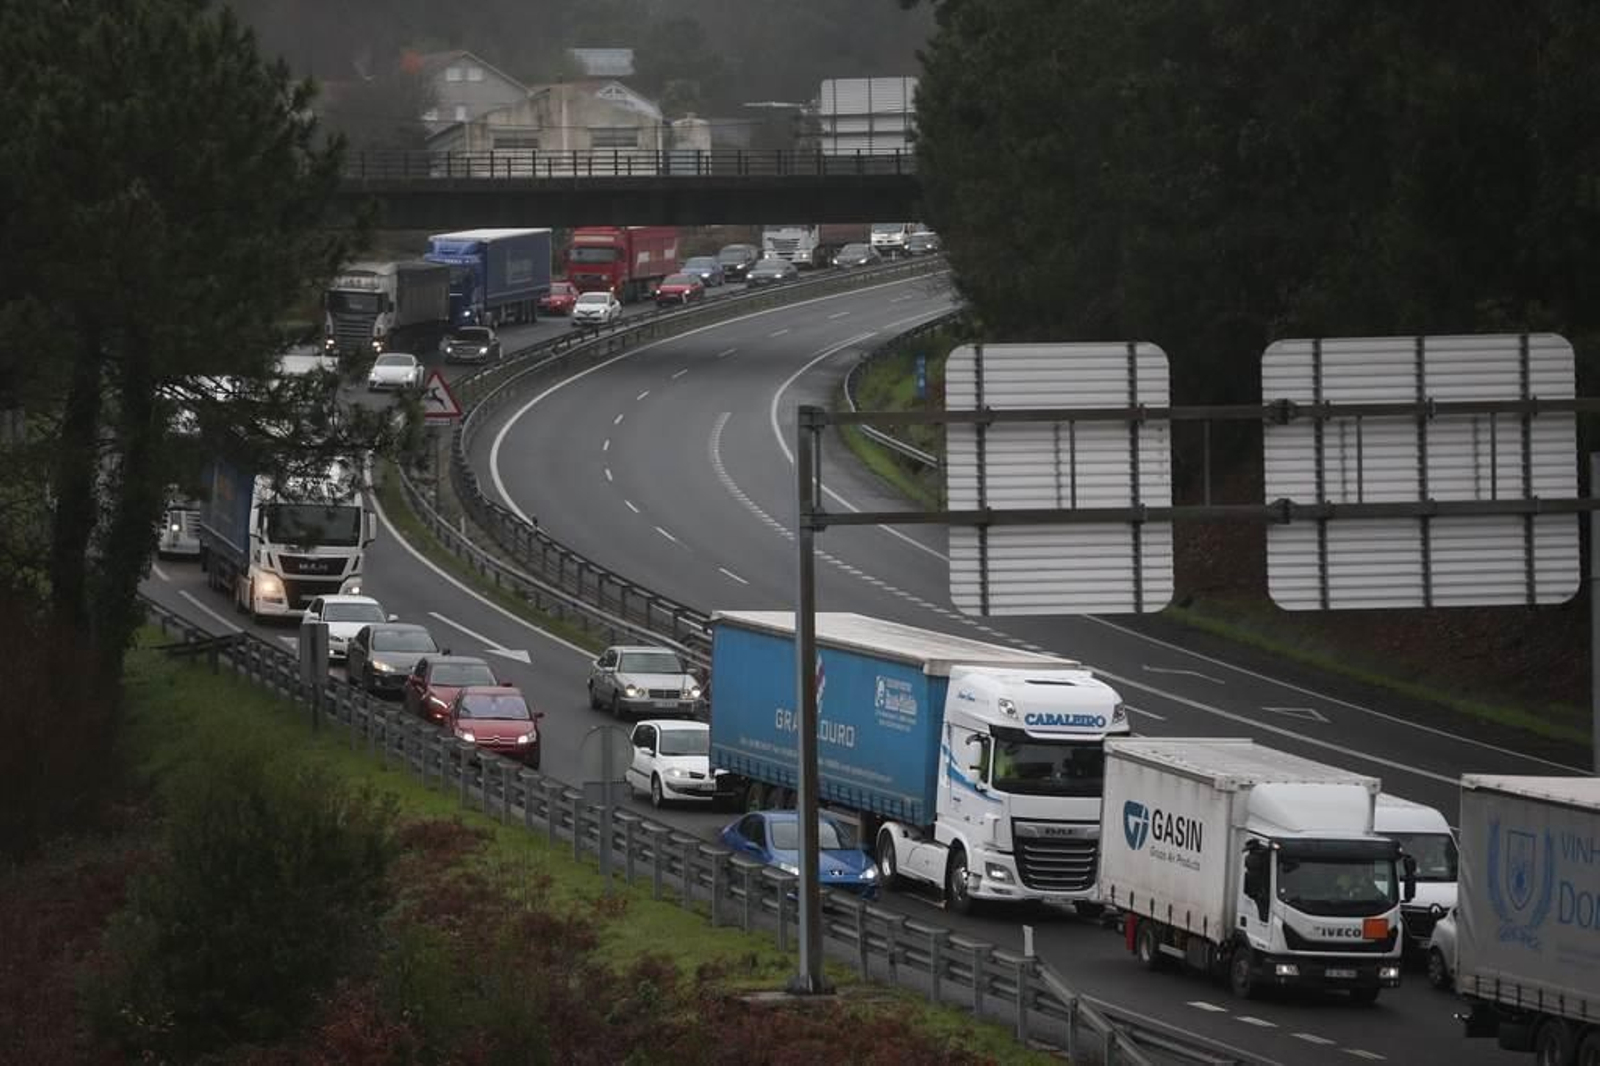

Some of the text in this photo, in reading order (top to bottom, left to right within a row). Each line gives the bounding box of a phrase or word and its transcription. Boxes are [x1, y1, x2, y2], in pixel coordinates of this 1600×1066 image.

[1024, 713, 1107, 728] CABALEIRO
[1152, 808, 1203, 853] GASIN
[1321, 926, 1362, 938] IVECO
